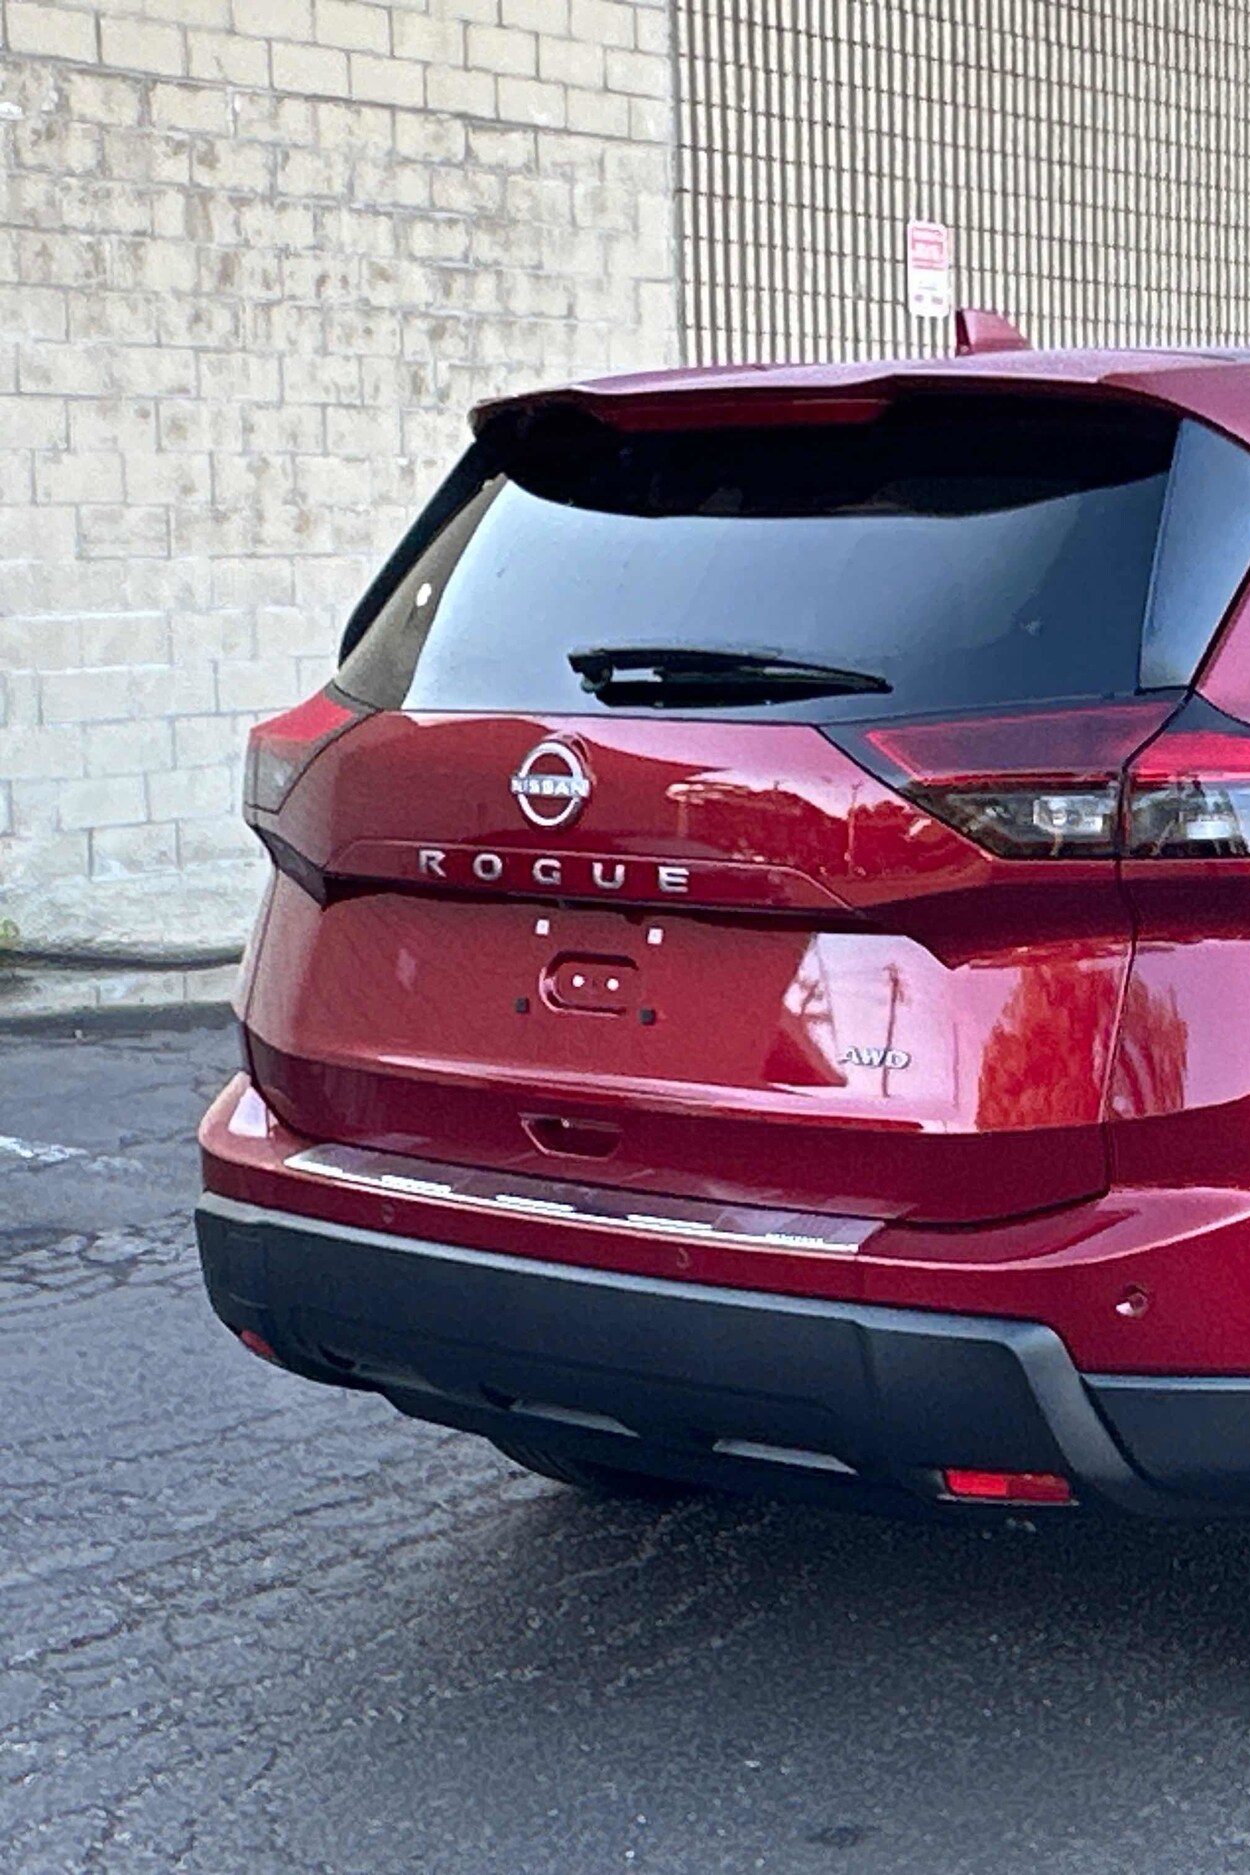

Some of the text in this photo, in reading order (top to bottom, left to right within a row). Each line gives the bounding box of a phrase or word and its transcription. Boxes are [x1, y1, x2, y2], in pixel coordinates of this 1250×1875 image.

[511, 777, 590, 798] NISSAN
[418, 849, 690, 893] ROGUE
[838, 1046, 911, 1069] AWD
